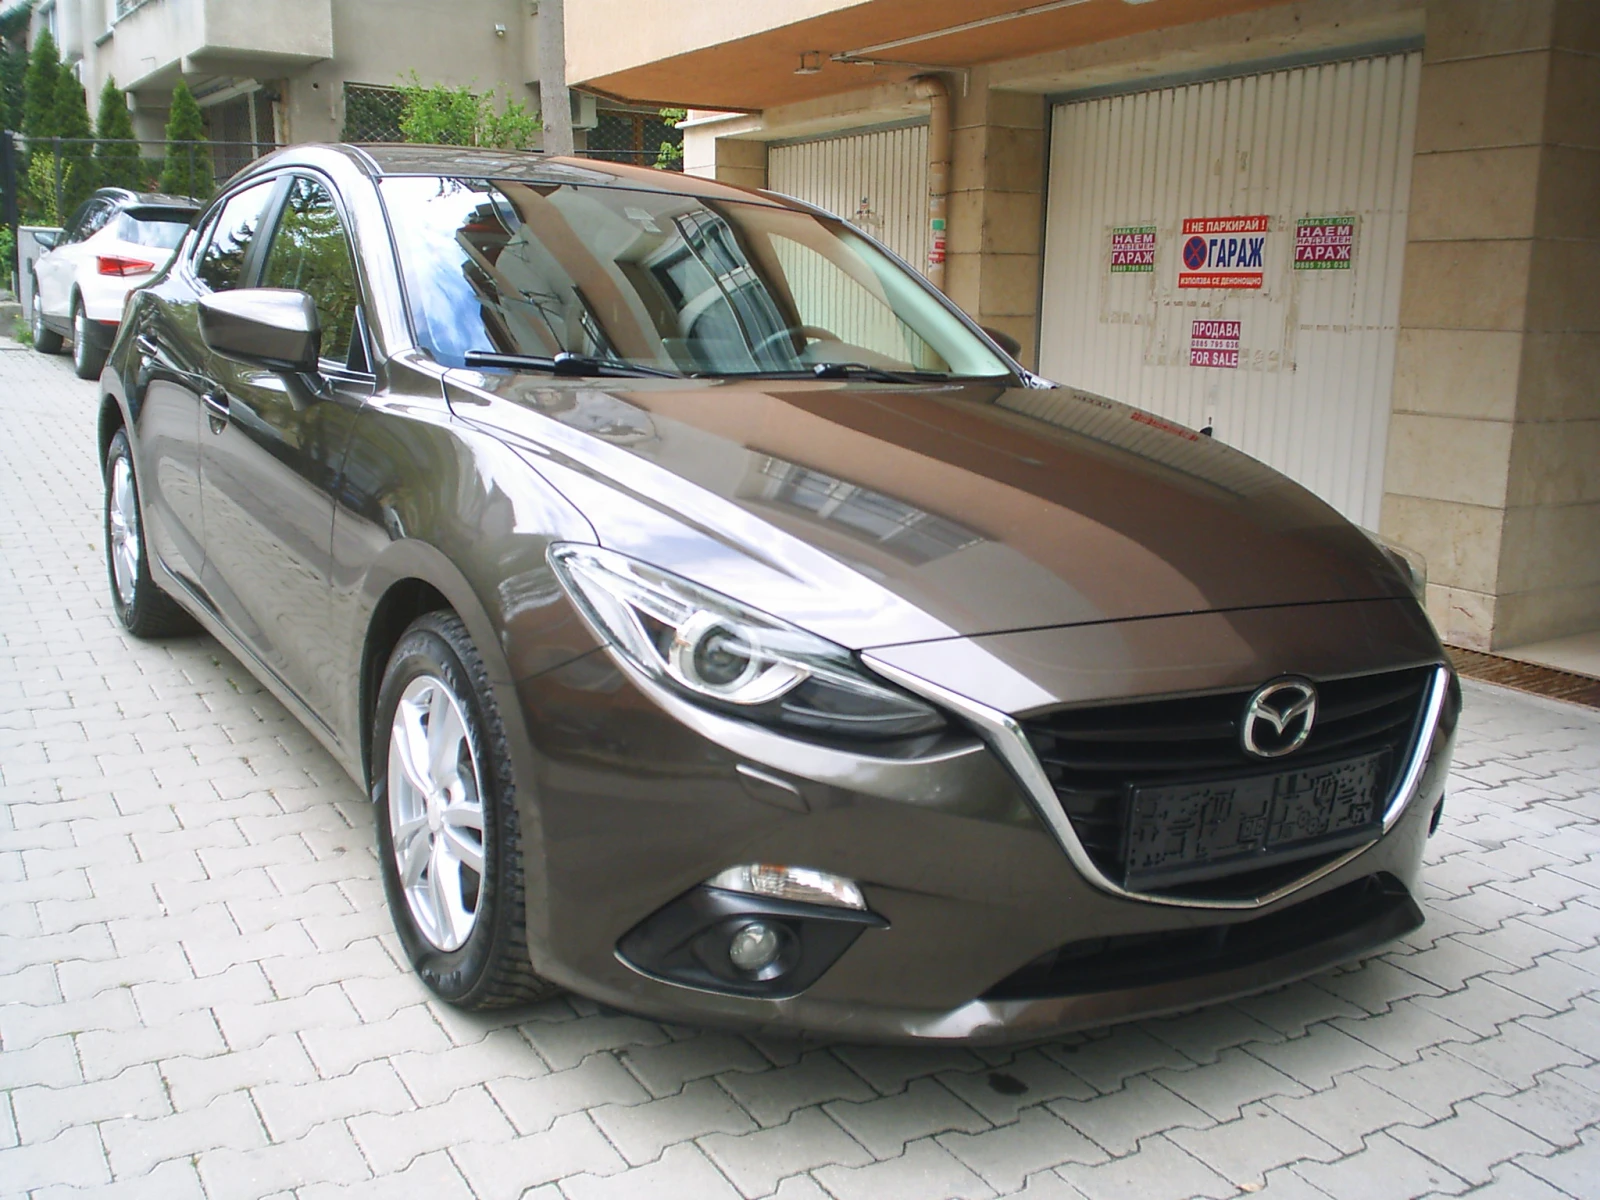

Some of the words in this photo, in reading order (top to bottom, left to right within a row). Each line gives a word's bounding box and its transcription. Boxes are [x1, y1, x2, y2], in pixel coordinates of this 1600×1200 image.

[1191, 222, 1204, 232] НЕ
[1206, 218, 1259, 232] ПАРКИРАЙ
[1300, 226, 1350, 236] НАЕМ
[1115, 234, 1153, 243] НАЕМ
[1112, 251, 1153, 264] ГАРАЖ
[1208, 237, 1264, 267] ГАРАЖ
[1295, 246, 1350, 260] ГАРАЖ
[1193, 322, 1239, 338] ПРОДАВА
[1191, 351, 1209, 365] FOR
[1212, 352, 1238, 366] SALE
